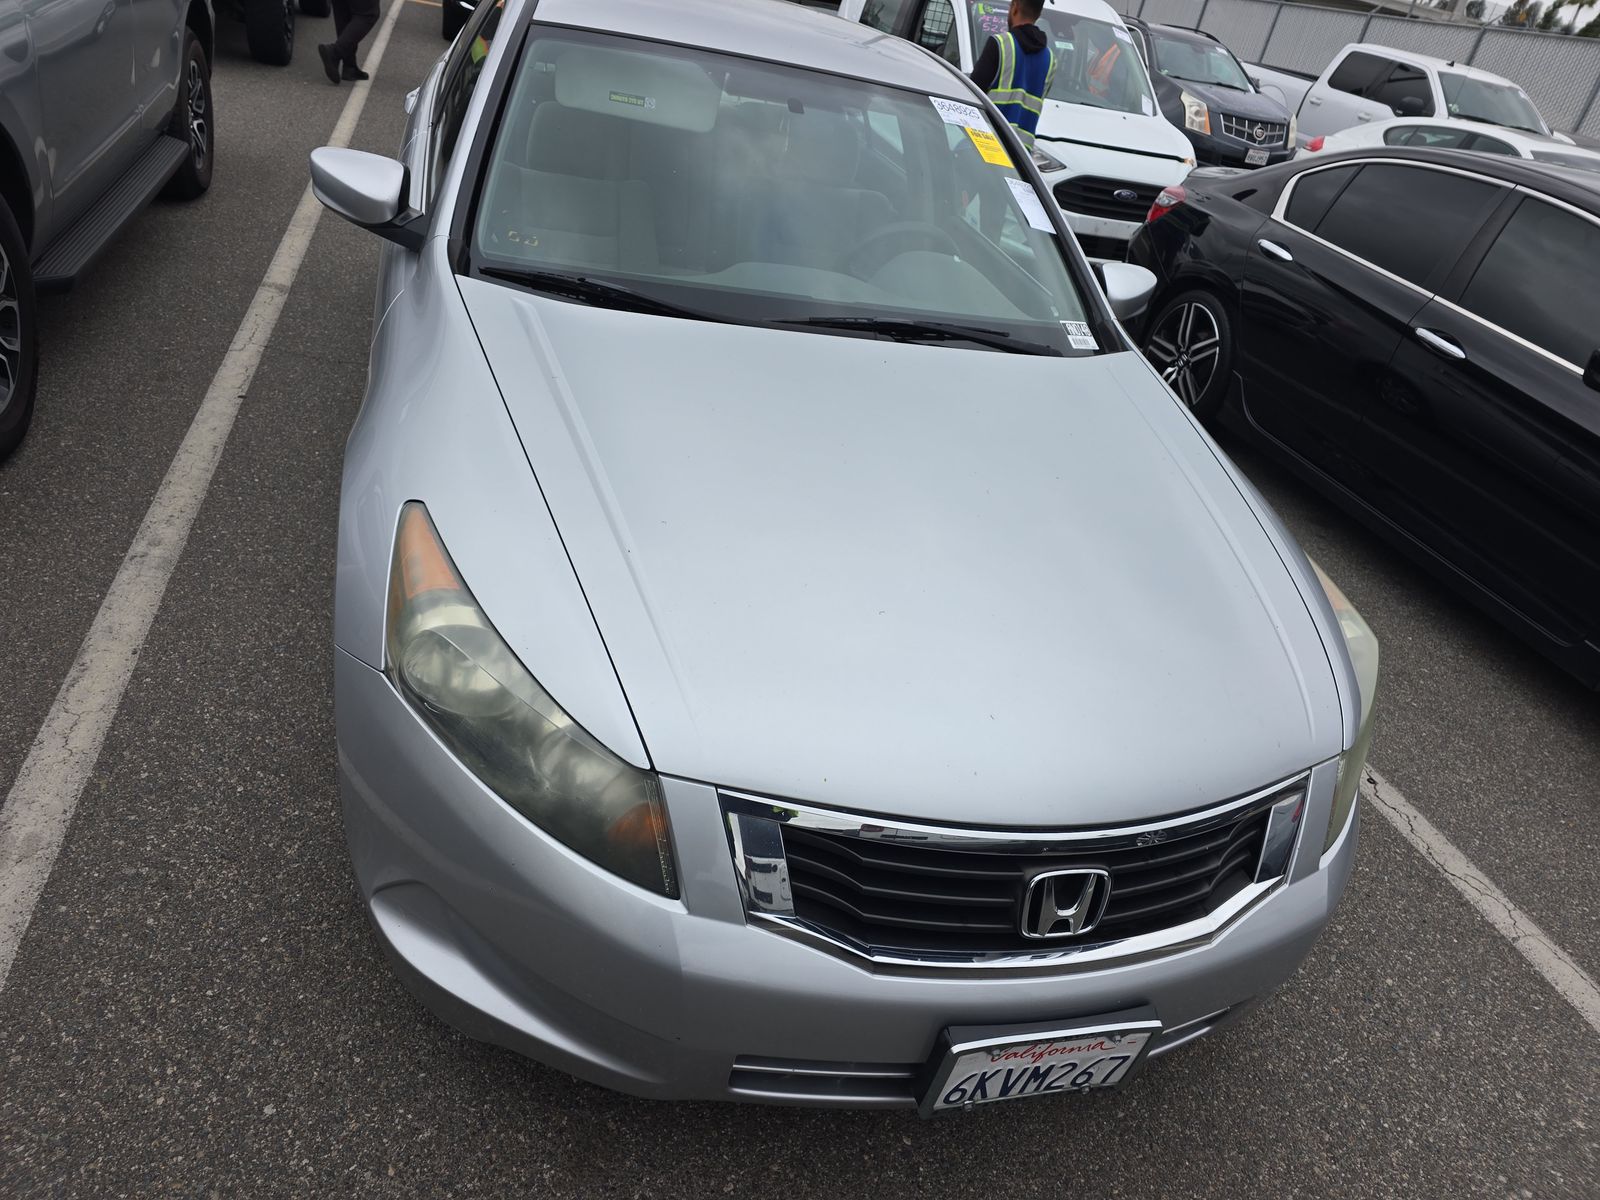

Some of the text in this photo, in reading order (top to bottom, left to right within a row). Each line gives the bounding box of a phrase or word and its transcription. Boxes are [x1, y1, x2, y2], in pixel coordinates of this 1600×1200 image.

[933, 100, 980, 119] 3648925
[991, 1041, 1115, 1064] California
[943, 1055, 1131, 1104] 6KVM267
